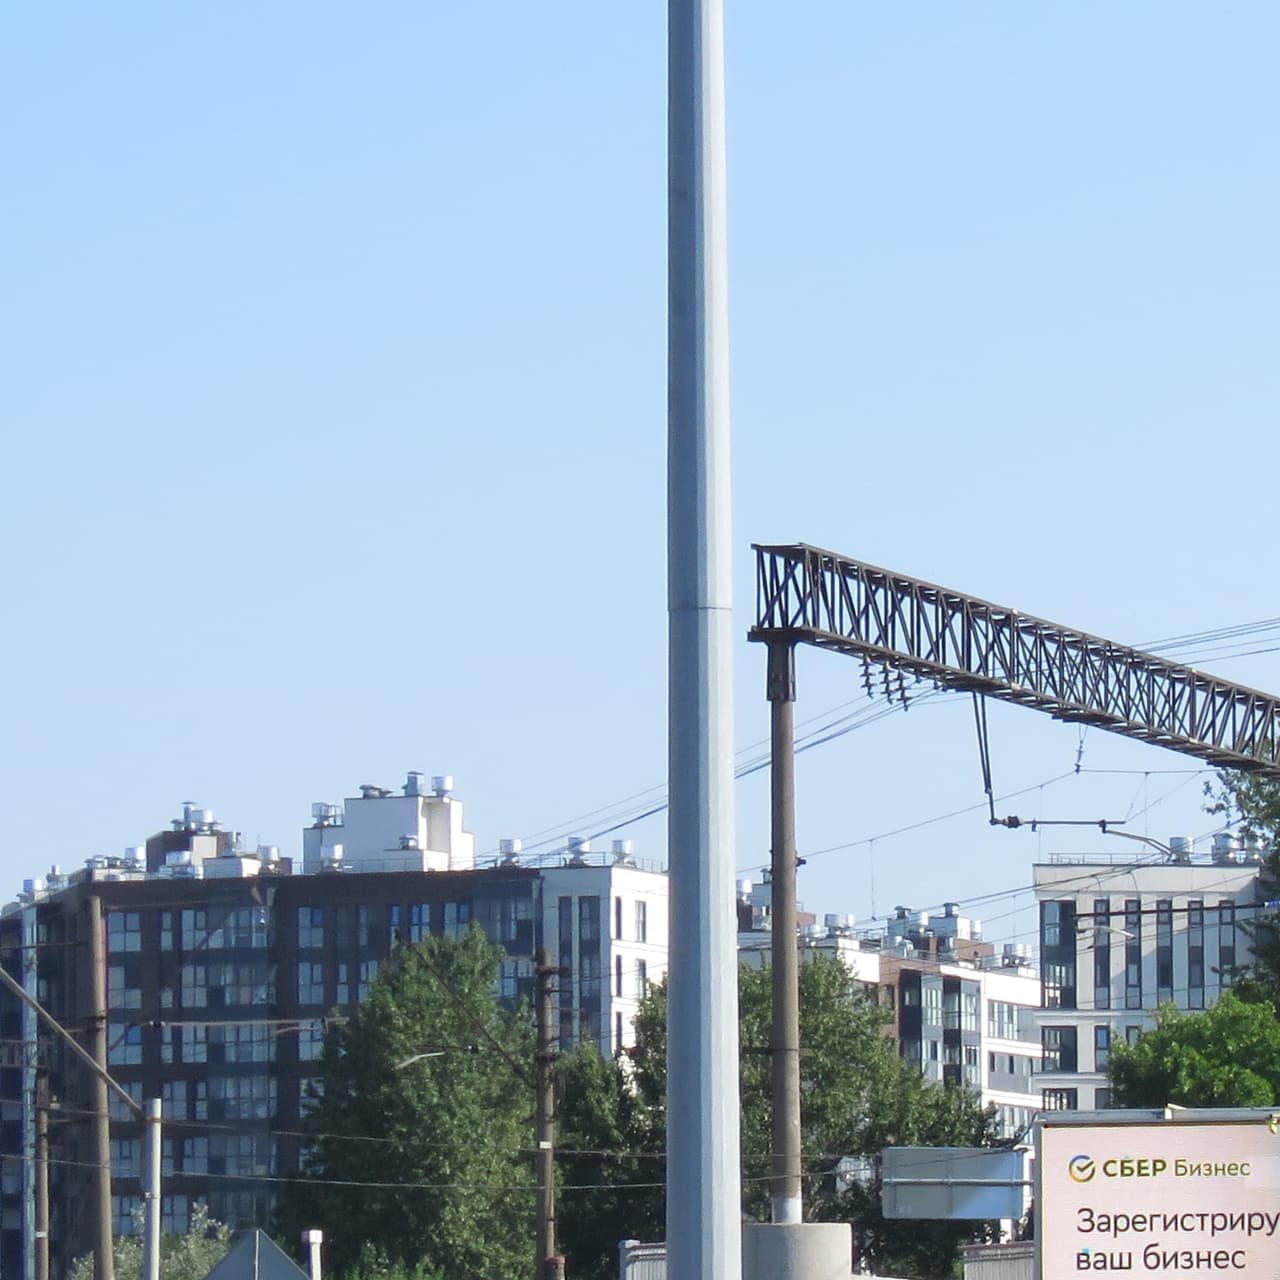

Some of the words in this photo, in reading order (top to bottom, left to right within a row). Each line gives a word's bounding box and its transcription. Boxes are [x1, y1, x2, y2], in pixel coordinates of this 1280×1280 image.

[1103, 1159, 1167, 1178] СБЕР
[1174, 1159, 1251, 1177] Бизнес
[1076, 1251, 1132, 1270] ваш
[1143, 1242, 1246, 1270] бизнес
